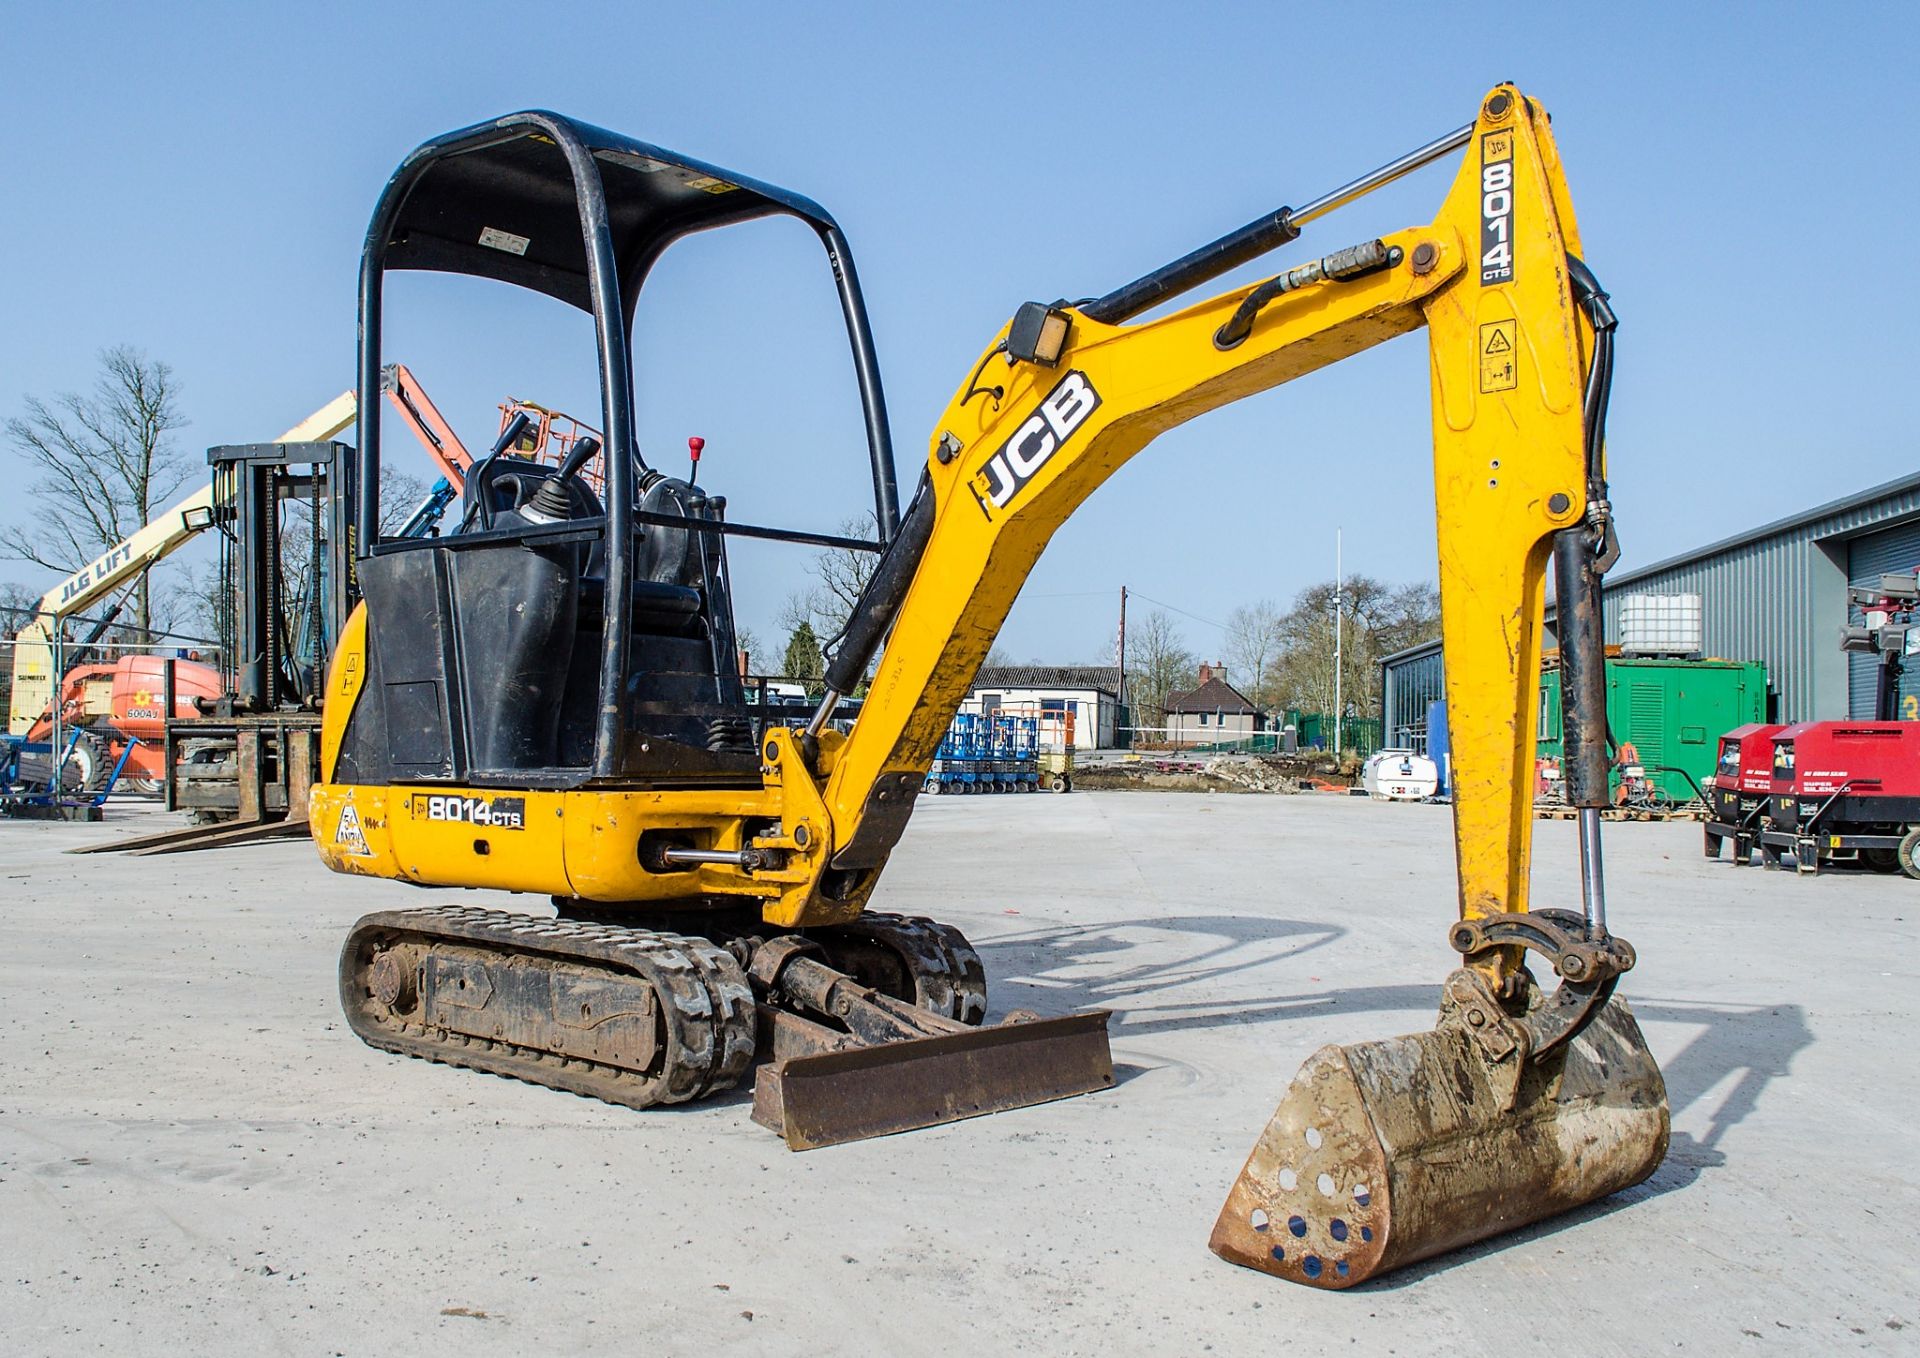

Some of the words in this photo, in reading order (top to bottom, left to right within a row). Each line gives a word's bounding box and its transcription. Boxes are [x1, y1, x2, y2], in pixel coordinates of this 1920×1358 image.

[1483, 162, 1512, 268] 8014
[1483, 267, 1511, 280] CTS
[981, 373, 1096, 509] JCB
[61, 571, 91, 604] JLG
[96, 543, 131, 580] LIFT
[349, 524, 357, 585] HYSTER
[127, 709, 158, 719] 600AJ
[1902, 695, 1918, 721] 3
[428, 796, 492, 825] 8014
[491, 811, 521, 826] CTS
